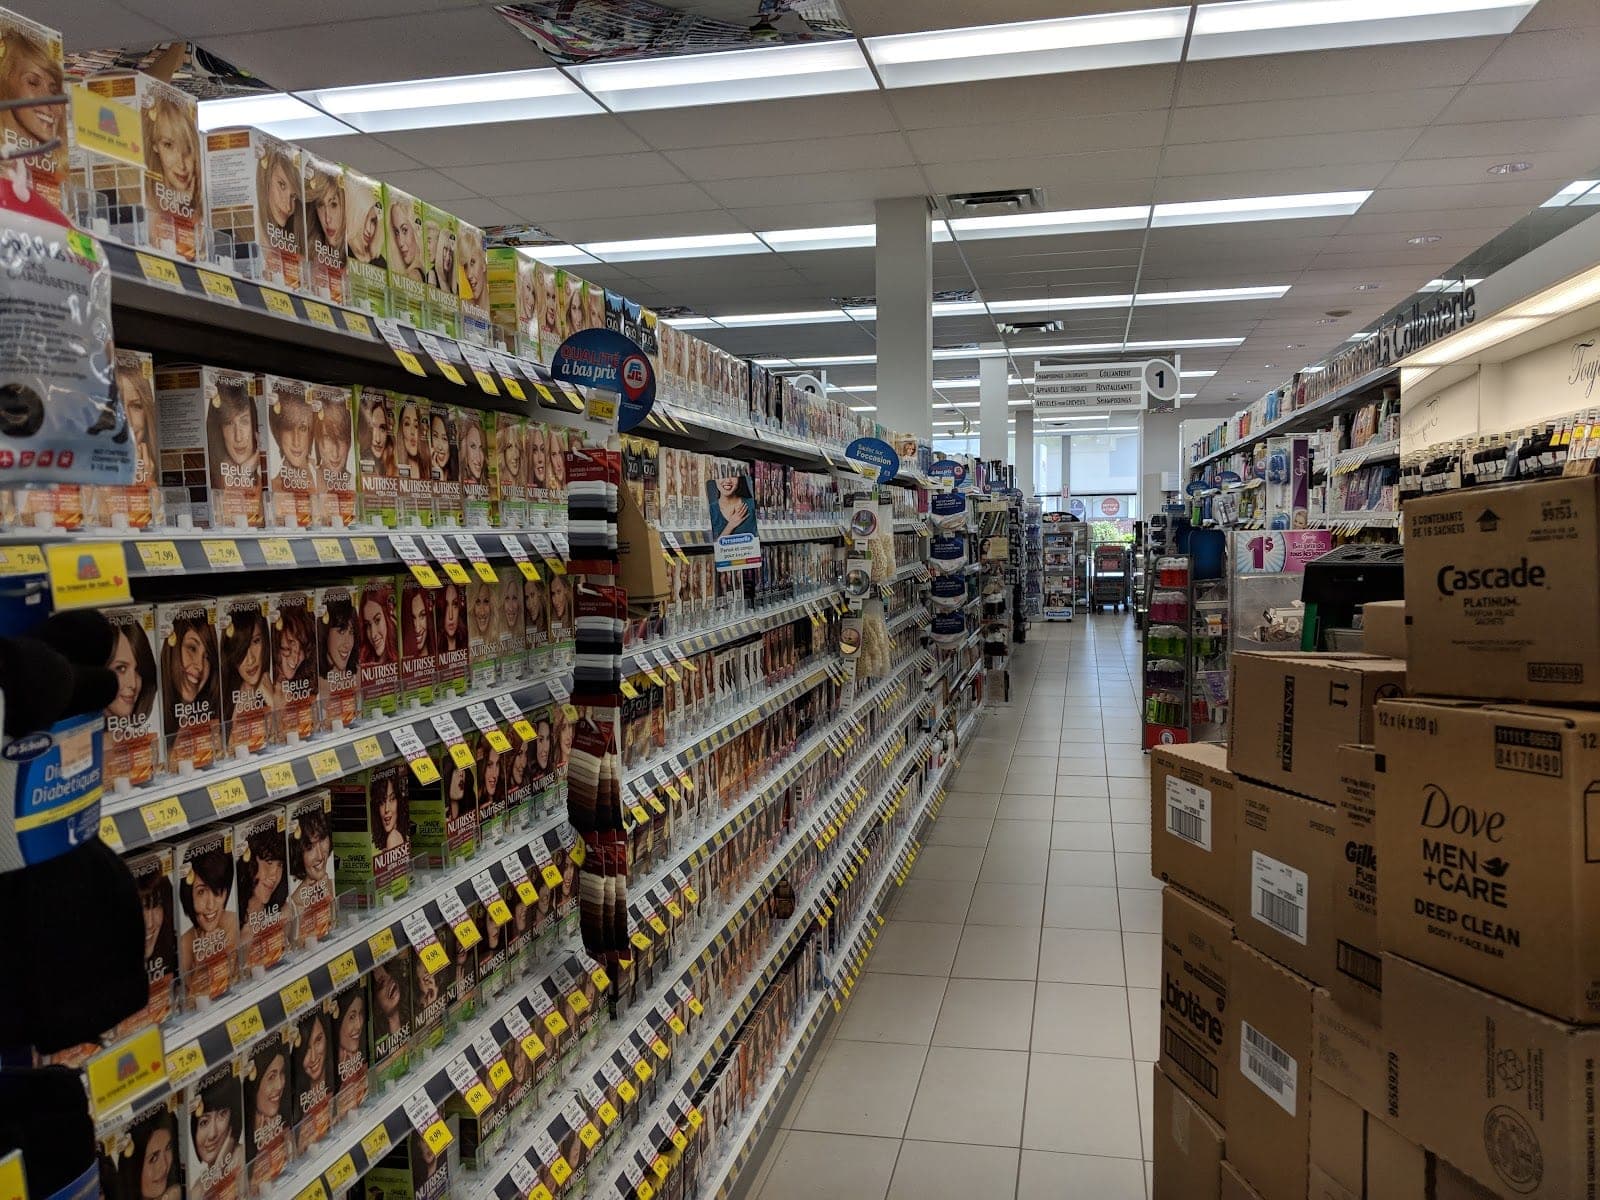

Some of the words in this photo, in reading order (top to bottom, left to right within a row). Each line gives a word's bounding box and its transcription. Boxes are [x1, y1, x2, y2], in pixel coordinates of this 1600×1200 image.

[155, 182, 192, 205] Belle
[160, 198, 194, 219] Color
[267, 222, 295, 243] Belle
[271, 236, 299, 254] Color
[315, 240, 339, 258] Belle
[318, 252, 343, 269] Color
[350, 263, 387, 283] NUTRISSE
[392, 275, 425, 295] NUTRISSE
[428, 287, 458, 306] NUTRISSE
[1376, 326, 1391, 367] La
[1392, 280, 1476, 357] Collanterie
[562, 359, 570, 374] à
[573, 361, 593, 377] bas
[593, 365, 617, 382] prix
[1154, 370, 1164, 389] 1
[221, 462, 251, 477] Belle
[280, 465, 307, 480] Belle
[323, 469, 349, 482] Belle
[225, 473, 256, 488] Color
[283, 476, 312, 490] Color
[327, 478, 352, 491] Color
[362, 477, 398, 492] NUTRISSE
[399, 479, 433, 494] NUTRISSE
[433, 482, 461, 495] NUTRISSE
[155, 551, 175, 561] 7.99
[218, 548, 236, 559] 7.99
[1437, 556, 1545, 596] Cascade
[1463, 596, 1517, 608] PLATINUM
[403, 656, 436, 674] NUTRISSE
[439, 648, 468, 665] NUTRISSE
[327, 669, 353, 683] Belle
[361, 662, 398, 682] NUTRISSE
[281, 677, 310, 692] Belle
[329, 678, 357, 692] Color
[232, 688, 263, 704] Belle
[285, 687, 312, 702] Color
[175, 699, 209, 718] Belle
[236, 697, 265, 713] Color
[107, 712, 147, 732] Belle
[178, 710, 213, 727] Color
[1378, 712, 1388, 725] 12
[112, 725, 151, 743] Color
[1580, 733, 1597, 749] 12
[276, 771, 291, 781] 7.99
[224, 787, 242, 798] 7.99
[160, 807, 178, 819] 7.99
[292, 800, 323, 817] GARNIER
[1421, 784, 1506, 843] Dove
[447, 810, 477, 833] NUTRISSE
[183, 839, 222, 862] GARNIER
[374, 842, 411, 869] NUTRISSE
[1423, 838, 1477, 873] MEN
[300, 878, 326, 899] Belle
[1423, 867, 1508, 908] +CARE
[302, 888, 329, 907] Color
[249, 903, 280, 925] Belle
[1415, 898, 1458, 925] DEEP
[1461, 914, 1521, 947] CLEAN
[252, 913, 282, 935] Color
[193, 929, 225, 953] Belle
[196, 941, 228, 961] Color
[426, 950, 438, 961] 9.99
[1484, 944, 1505, 958] BAR
[340, 959, 354, 971] 7.99
[479, 950, 506, 976] NUTRISSE
[293, 986, 308, 999] 7.99
[446, 971, 475, 1002] NUTRISSE
[415, 994, 449, 1028] NUTRISSE
[242, 1015, 257, 1029] 7.99
[375, 1022, 410, 1058] NUTRISSE
[338, 1051, 362, 1075] Belle
[300, 1080, 325, 1104] Belle
[302, 1088, 330, 1113] Color
[471, 1092, 482, 1103] 9.99
[372, 1133, 387, 1147] 7.99
[430, 1131, 442, 1143] 9.99
[334, 1164, 351, 1181] 7.99
